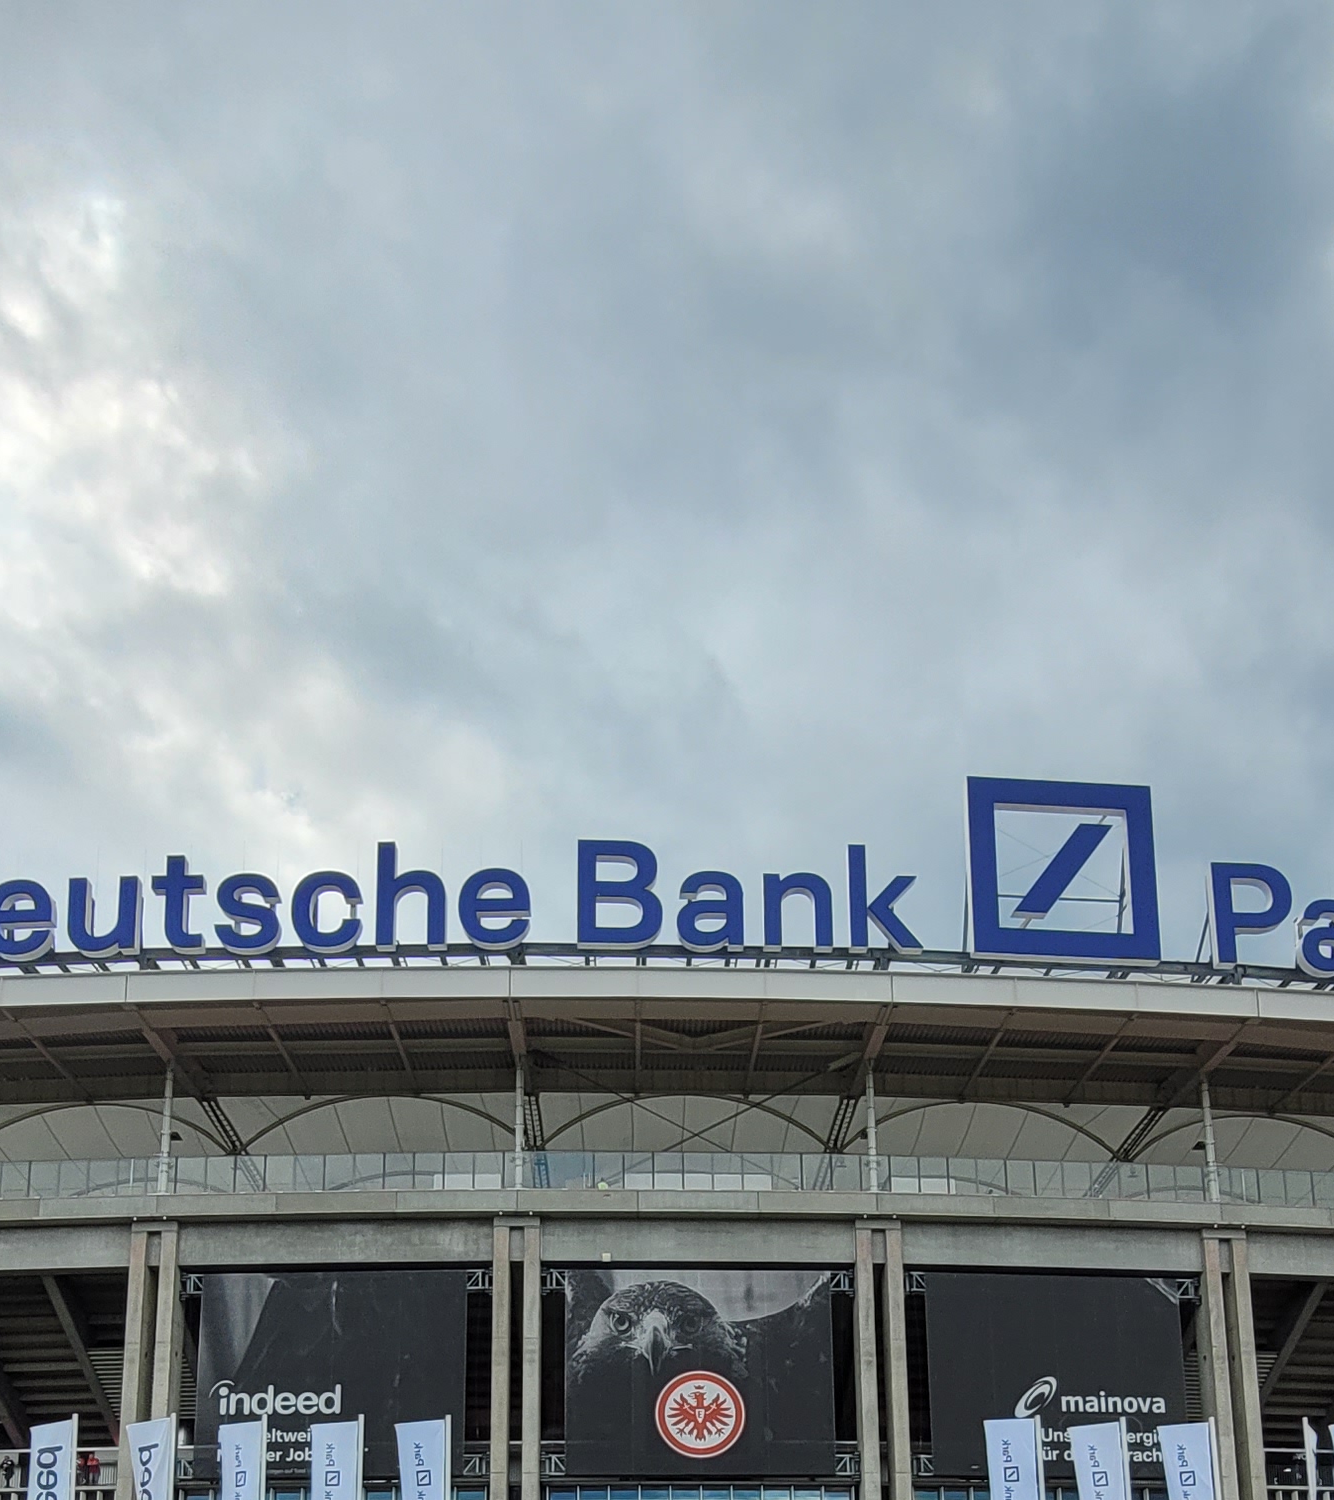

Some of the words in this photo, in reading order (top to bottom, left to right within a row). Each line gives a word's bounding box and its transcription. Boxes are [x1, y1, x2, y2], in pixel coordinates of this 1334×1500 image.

[578, 838, 923, 954] Bank
[217, 1382, 343, 1416] indeed
[1060, 1391, 1167, 1414] mainova
[265, 1428, 312, 1442] eltwei
